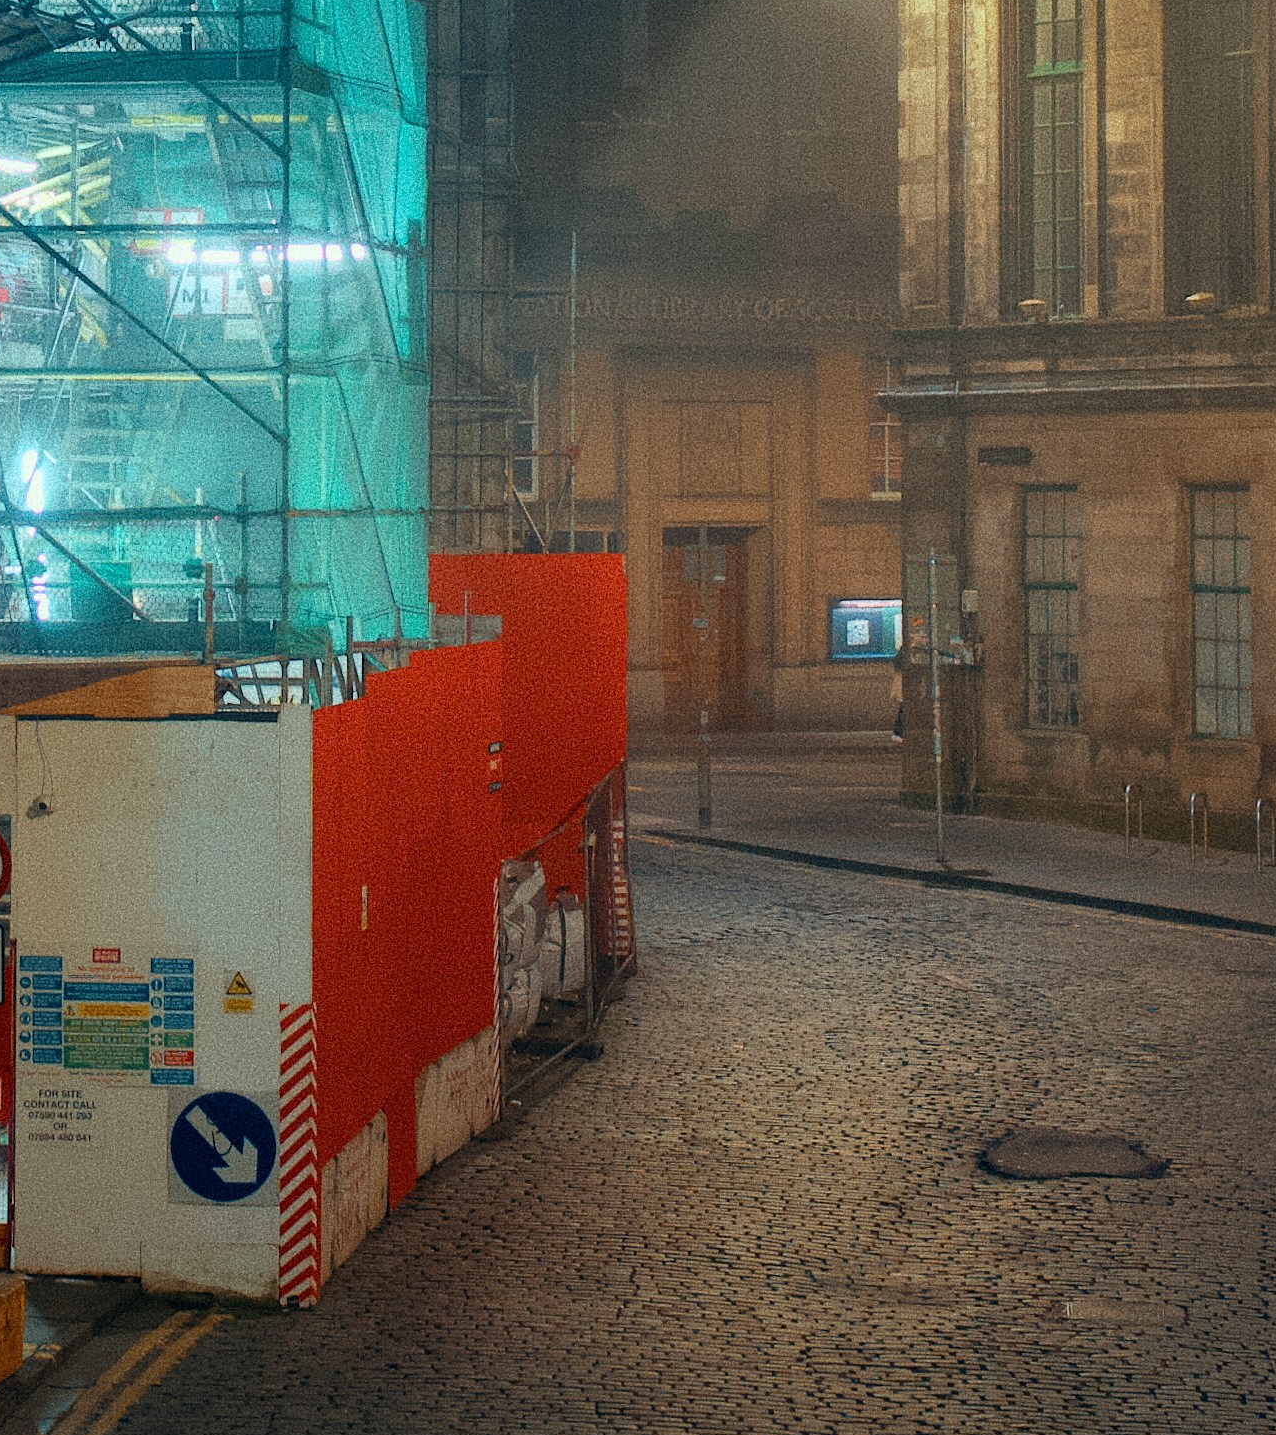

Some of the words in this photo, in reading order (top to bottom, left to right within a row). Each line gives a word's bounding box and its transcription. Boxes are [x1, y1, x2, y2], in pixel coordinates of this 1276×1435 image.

[38, 1089, 59, 1098] FOR
[61, 1089, 83, 1099] SITE
[23, 1100, 70, 1110] CONTACT
[72, 1100, 97, 1110] CALL
[53, 1122, 68, 1130] OR
